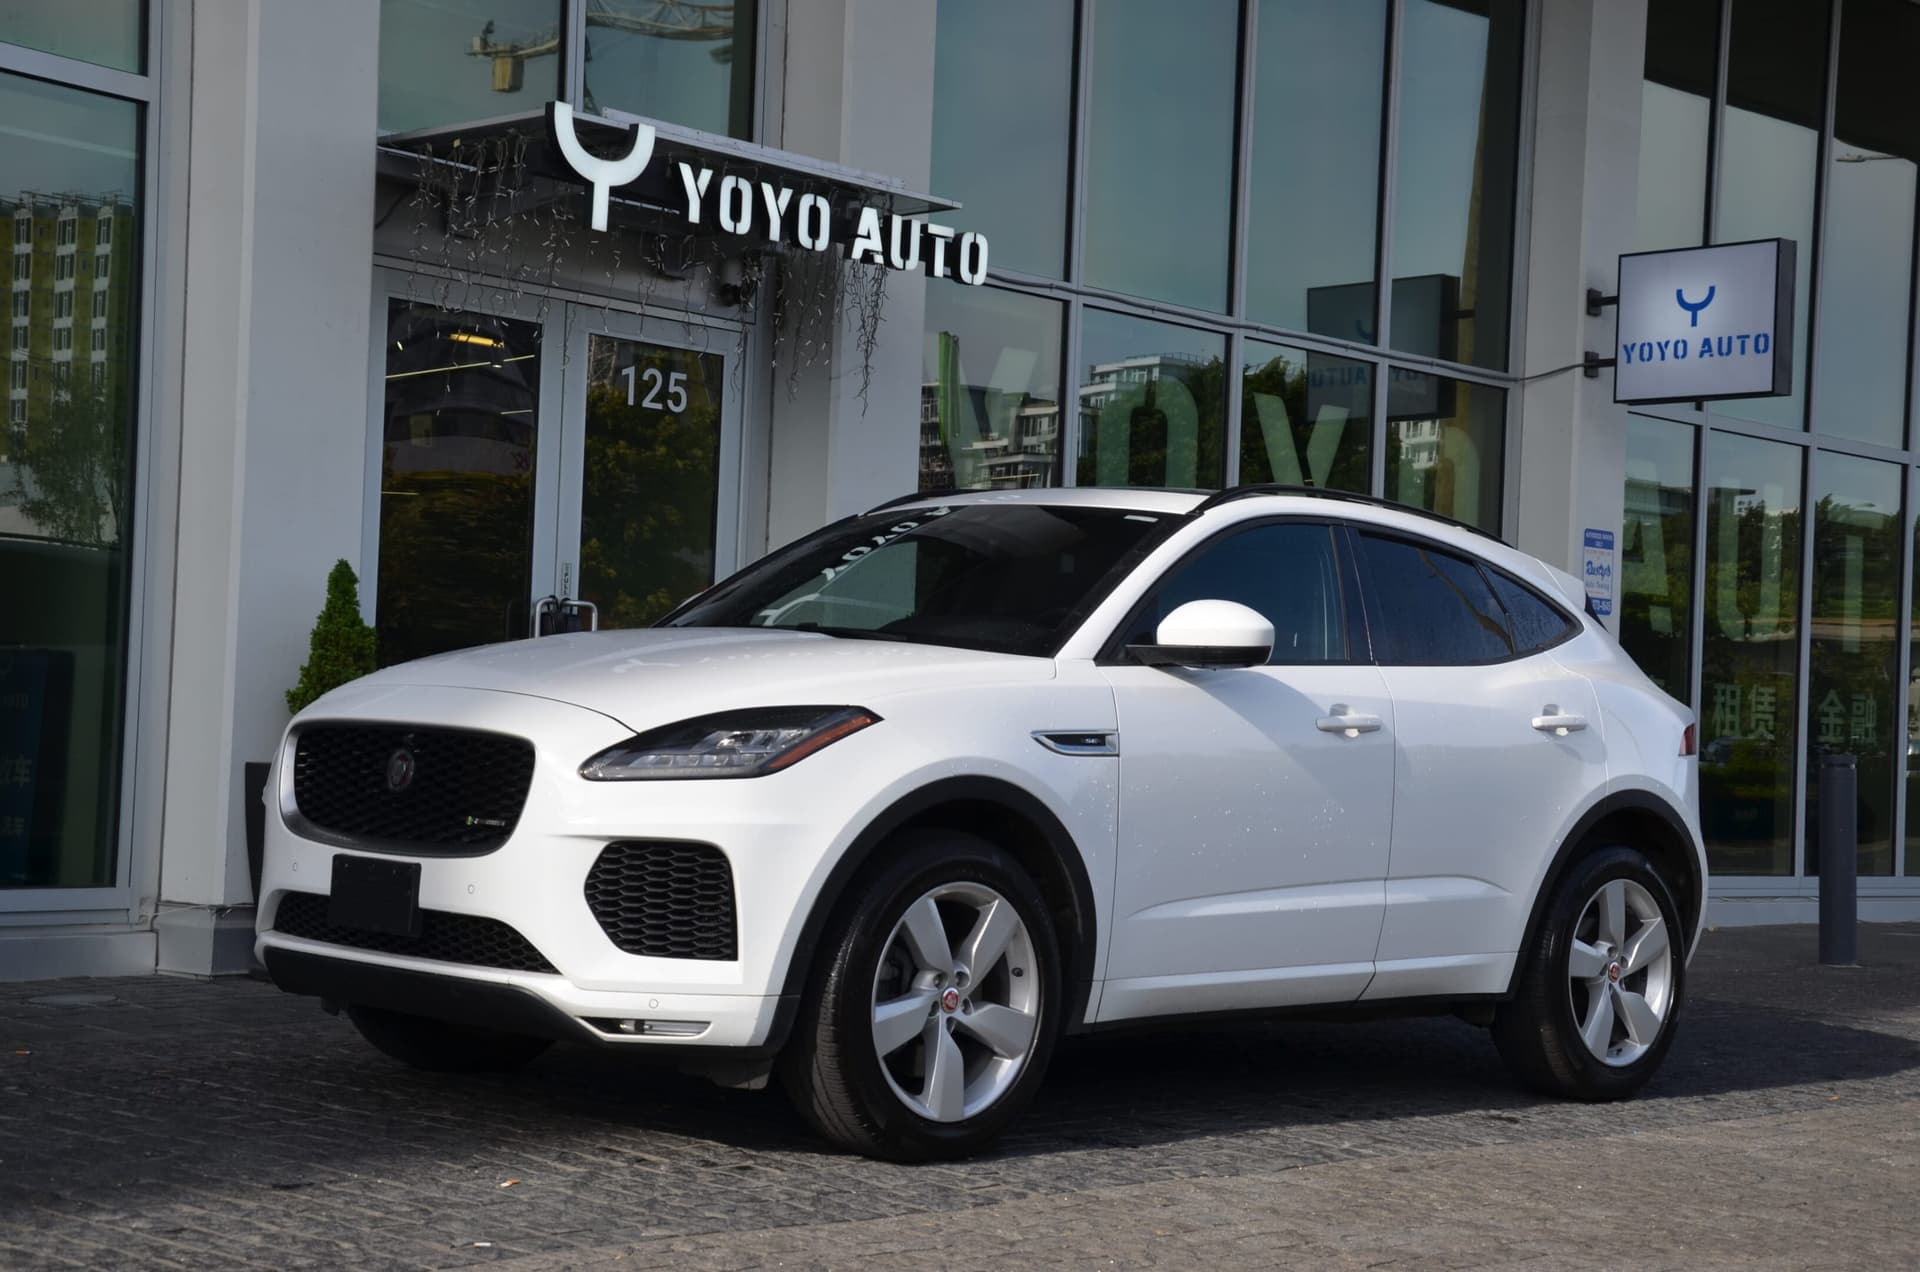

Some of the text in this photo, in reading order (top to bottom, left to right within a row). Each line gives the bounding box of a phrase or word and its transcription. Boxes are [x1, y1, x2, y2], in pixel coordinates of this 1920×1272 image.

[678, 162, 989, 287] YOYO AUTO
[1622, 332, 1770, 365] YOYO AUTO
[620, 365, 688, 414] 125
[1711, 683, 1777, 741] 租赁
